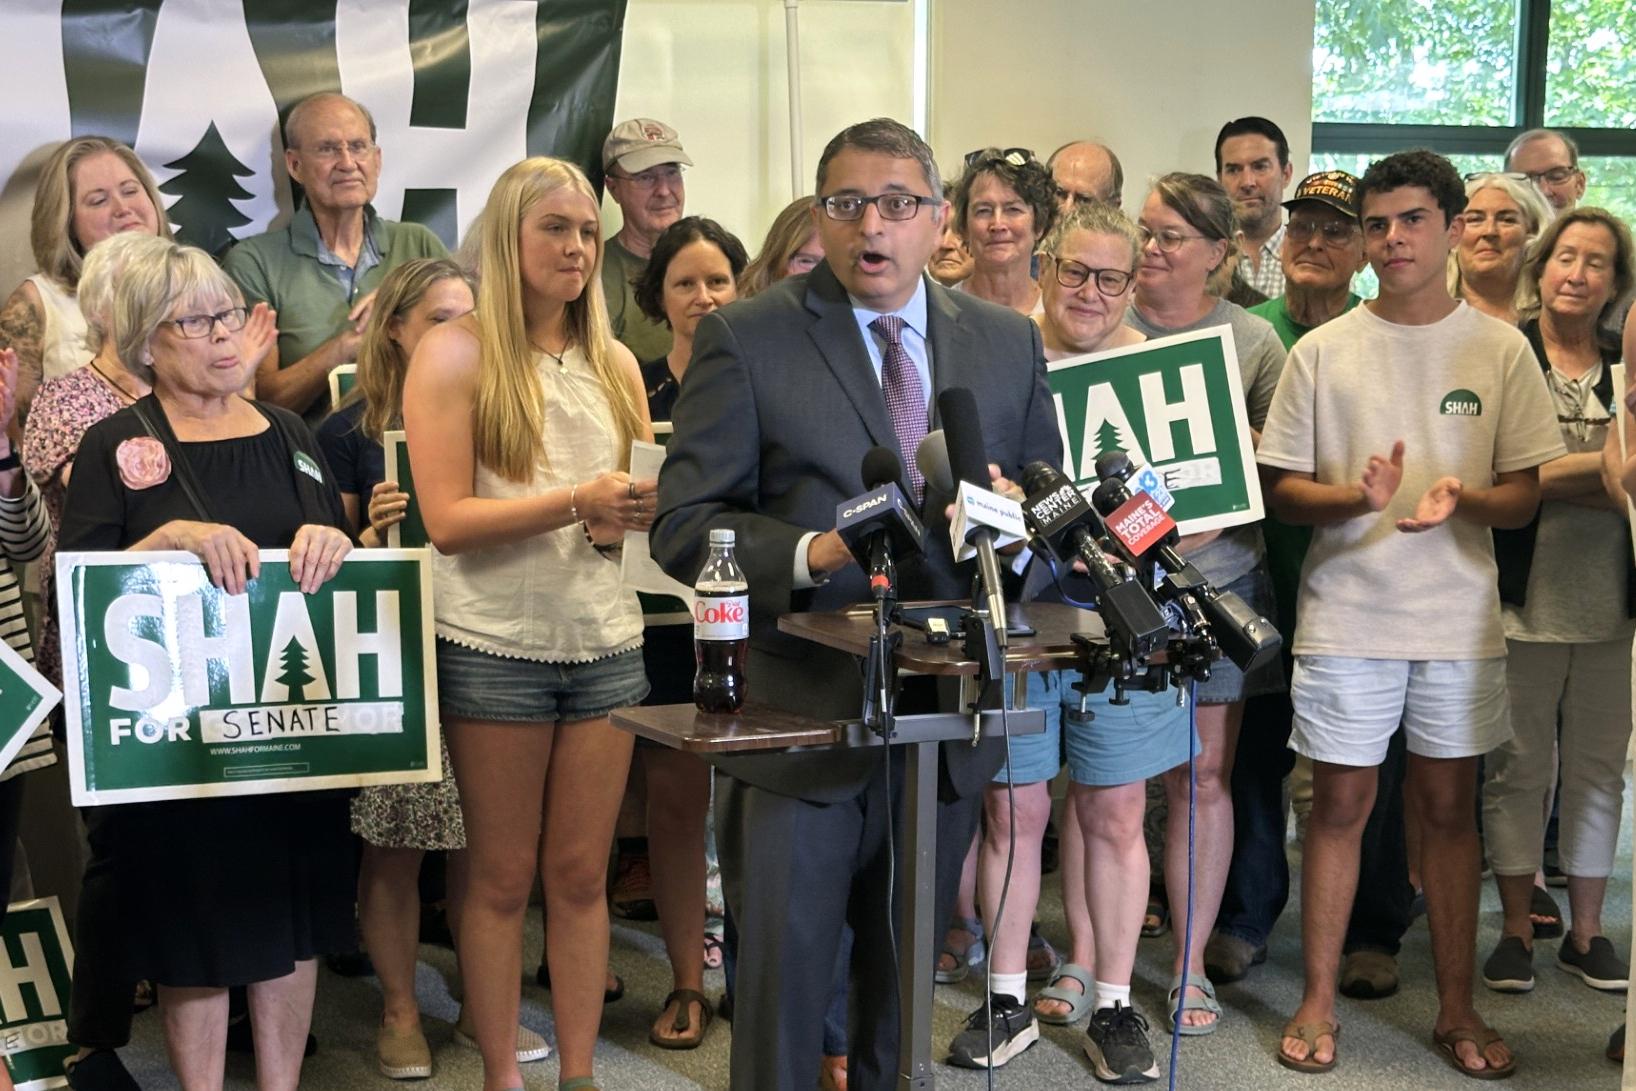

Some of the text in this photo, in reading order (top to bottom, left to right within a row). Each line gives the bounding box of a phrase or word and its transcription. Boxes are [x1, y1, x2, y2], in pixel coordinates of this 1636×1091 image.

[1303, 186, 1352, 205] VETERAN
[1053, 363, 1217, 481] AH
[1445, 401, 1478, 415] SHAH
[843, 494, 887, 518] C-SPAN
[976, 500, 1022, 523] maine public
[1031, 491, 1060, 515] NEWS
[1036, 489, 1077, 519] CENTER
[1041, 495, 1080, 527] MAINE
[1115, 499, 1153, 532] MAINE'S
[1121, 509, 1160, 539] TOTAL
[1128, 511, 1167, 546] COVERAGE
[695, 600, 744, 624] Coke
[104, 590, 403, 711] SHAH
[110, 716, 192, 746] FOR
[223, 705, 341, 739] SENATE
